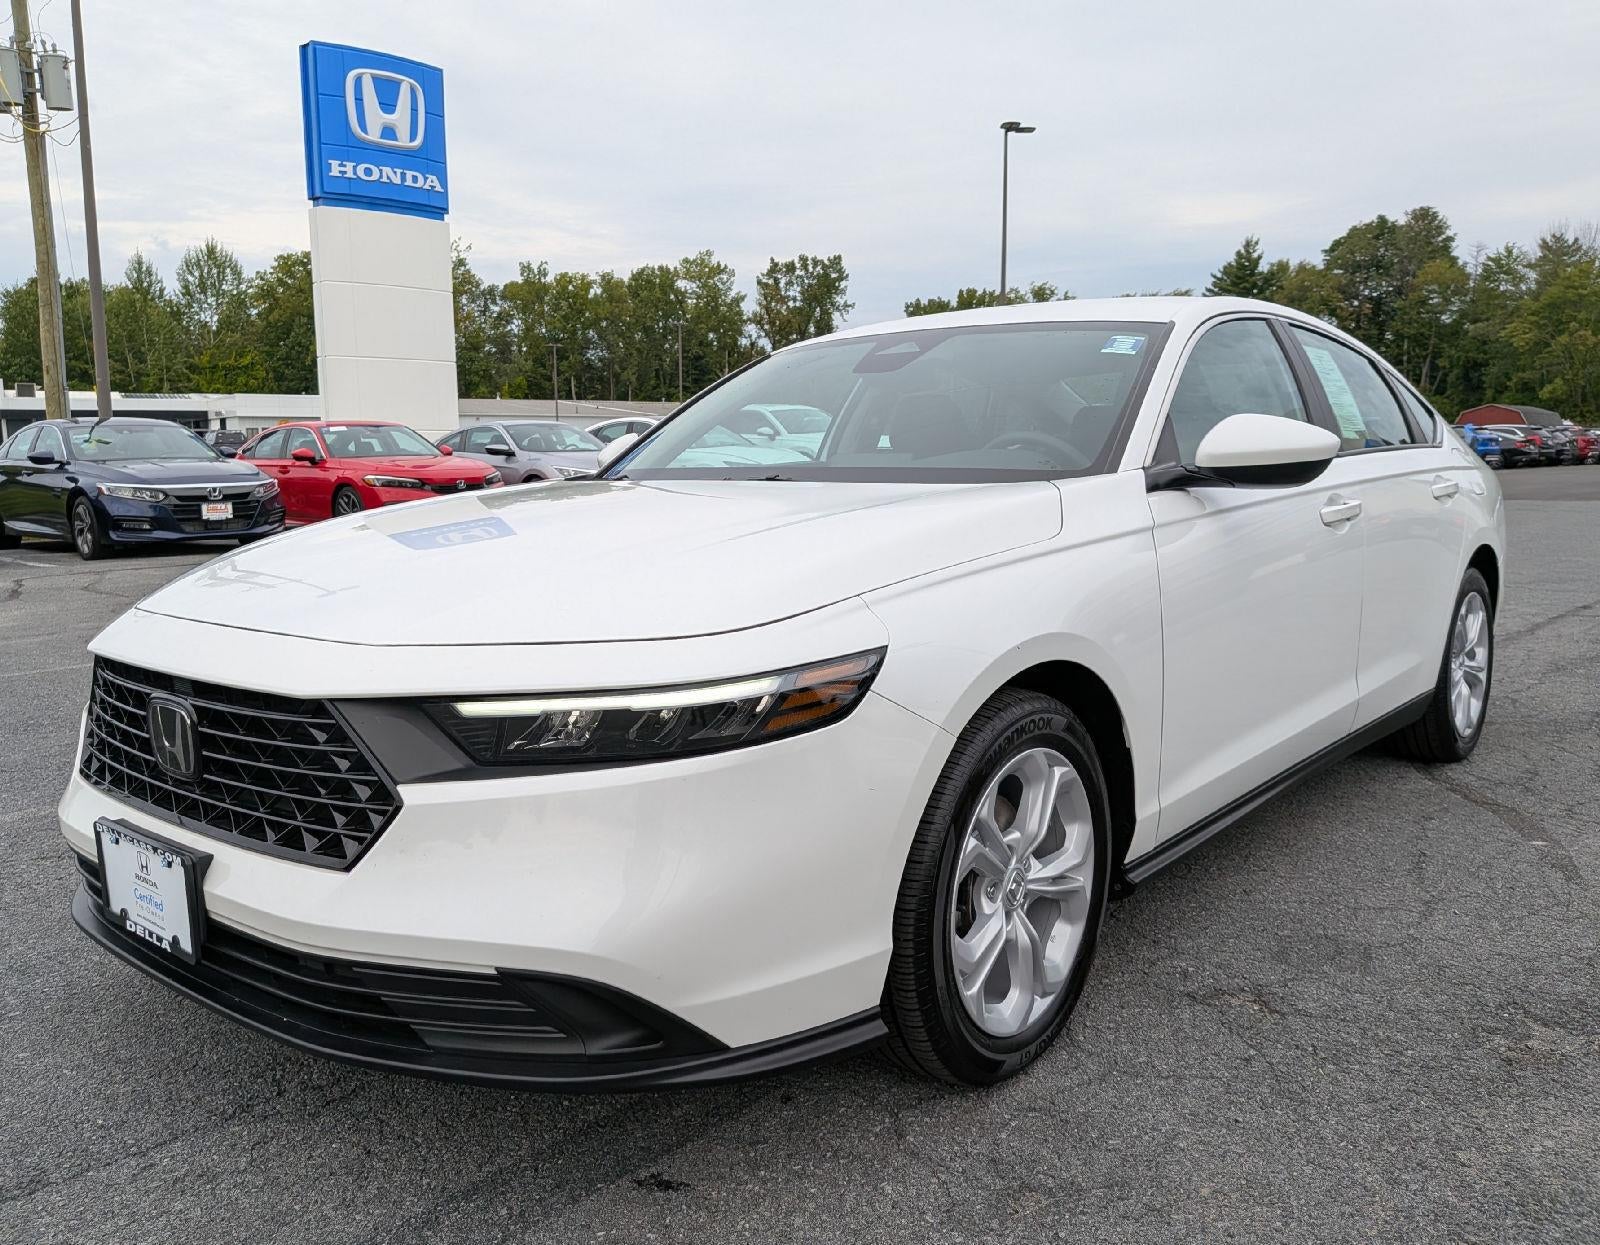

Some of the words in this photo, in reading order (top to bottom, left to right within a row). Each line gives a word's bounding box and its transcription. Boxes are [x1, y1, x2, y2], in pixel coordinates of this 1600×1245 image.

[328, 160, 445, 193] HONDA
[134, 873, 159, 890] HONDA
[133, 888, 164, 912] Certified
[126, 920, 171, 953] DELLA
